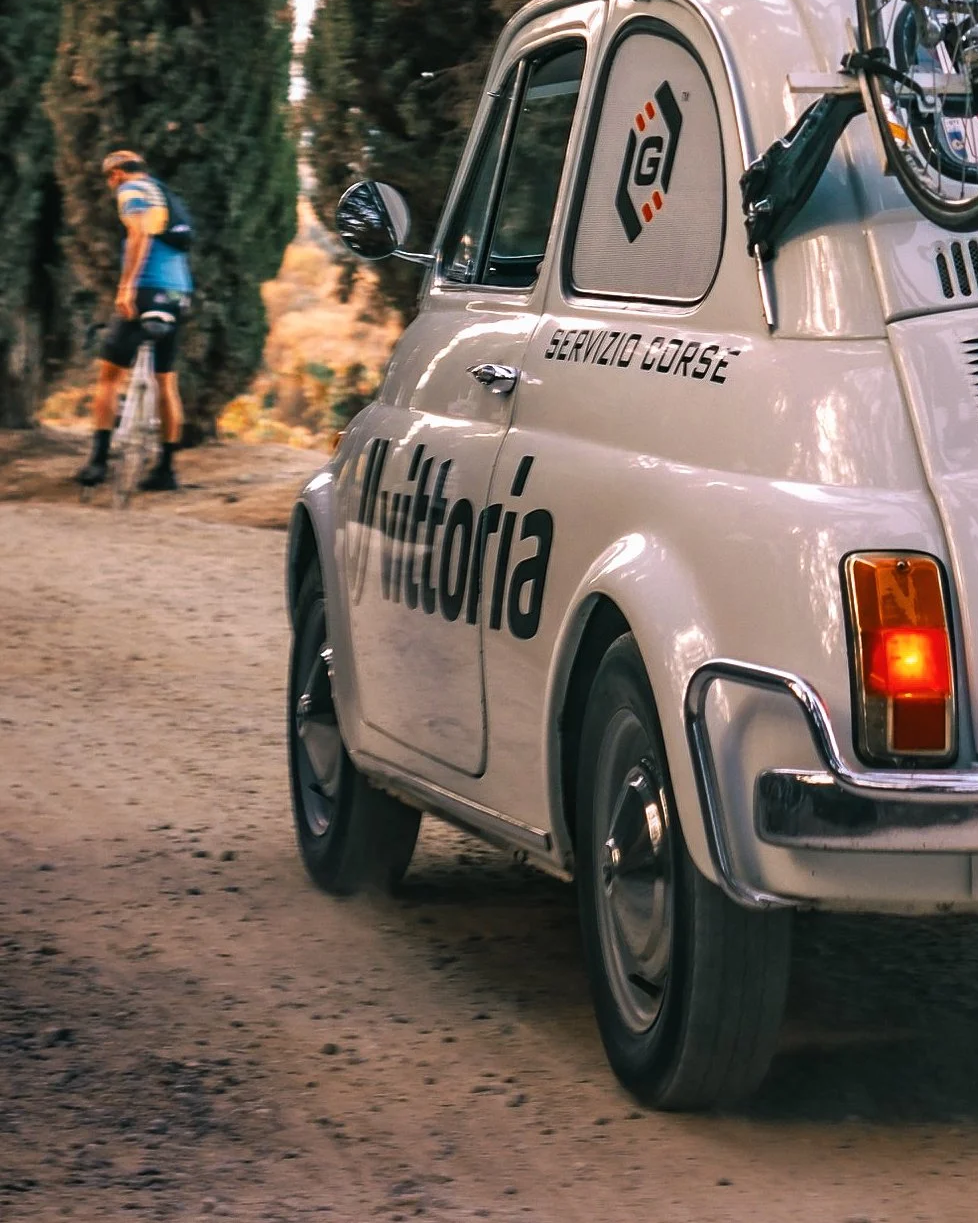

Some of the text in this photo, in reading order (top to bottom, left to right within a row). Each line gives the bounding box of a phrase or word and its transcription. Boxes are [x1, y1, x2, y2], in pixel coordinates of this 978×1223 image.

[634, 136, 664, 186] G
[544, 328, 742, 385] SERVIZIO CORSE
